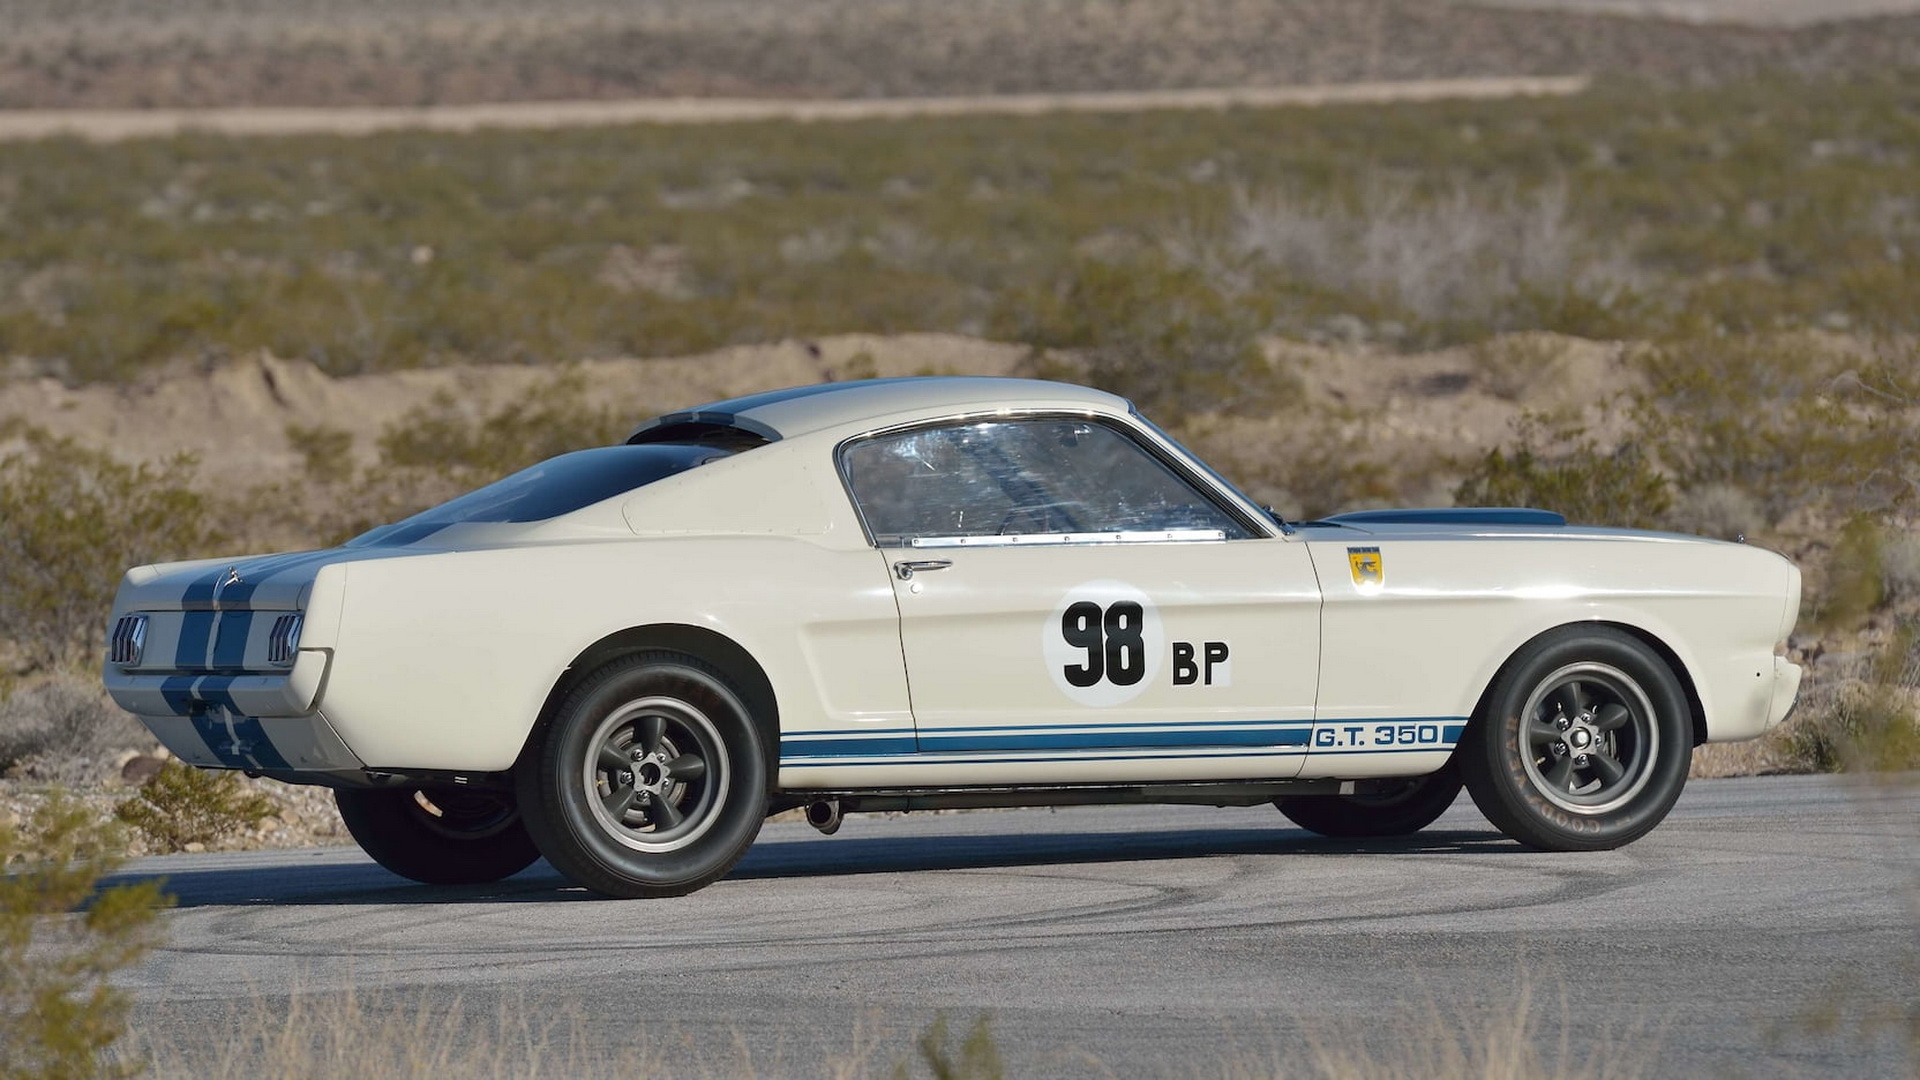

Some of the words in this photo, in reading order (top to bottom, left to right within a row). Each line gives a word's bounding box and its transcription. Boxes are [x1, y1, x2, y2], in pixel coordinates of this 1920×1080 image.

[1062, 600, 1146, 687] 98
[1172, 642, 1229, 685] BP
[1315, 727, 1365, 747] G.T.
[1374, 725, 1438, 745] 350
